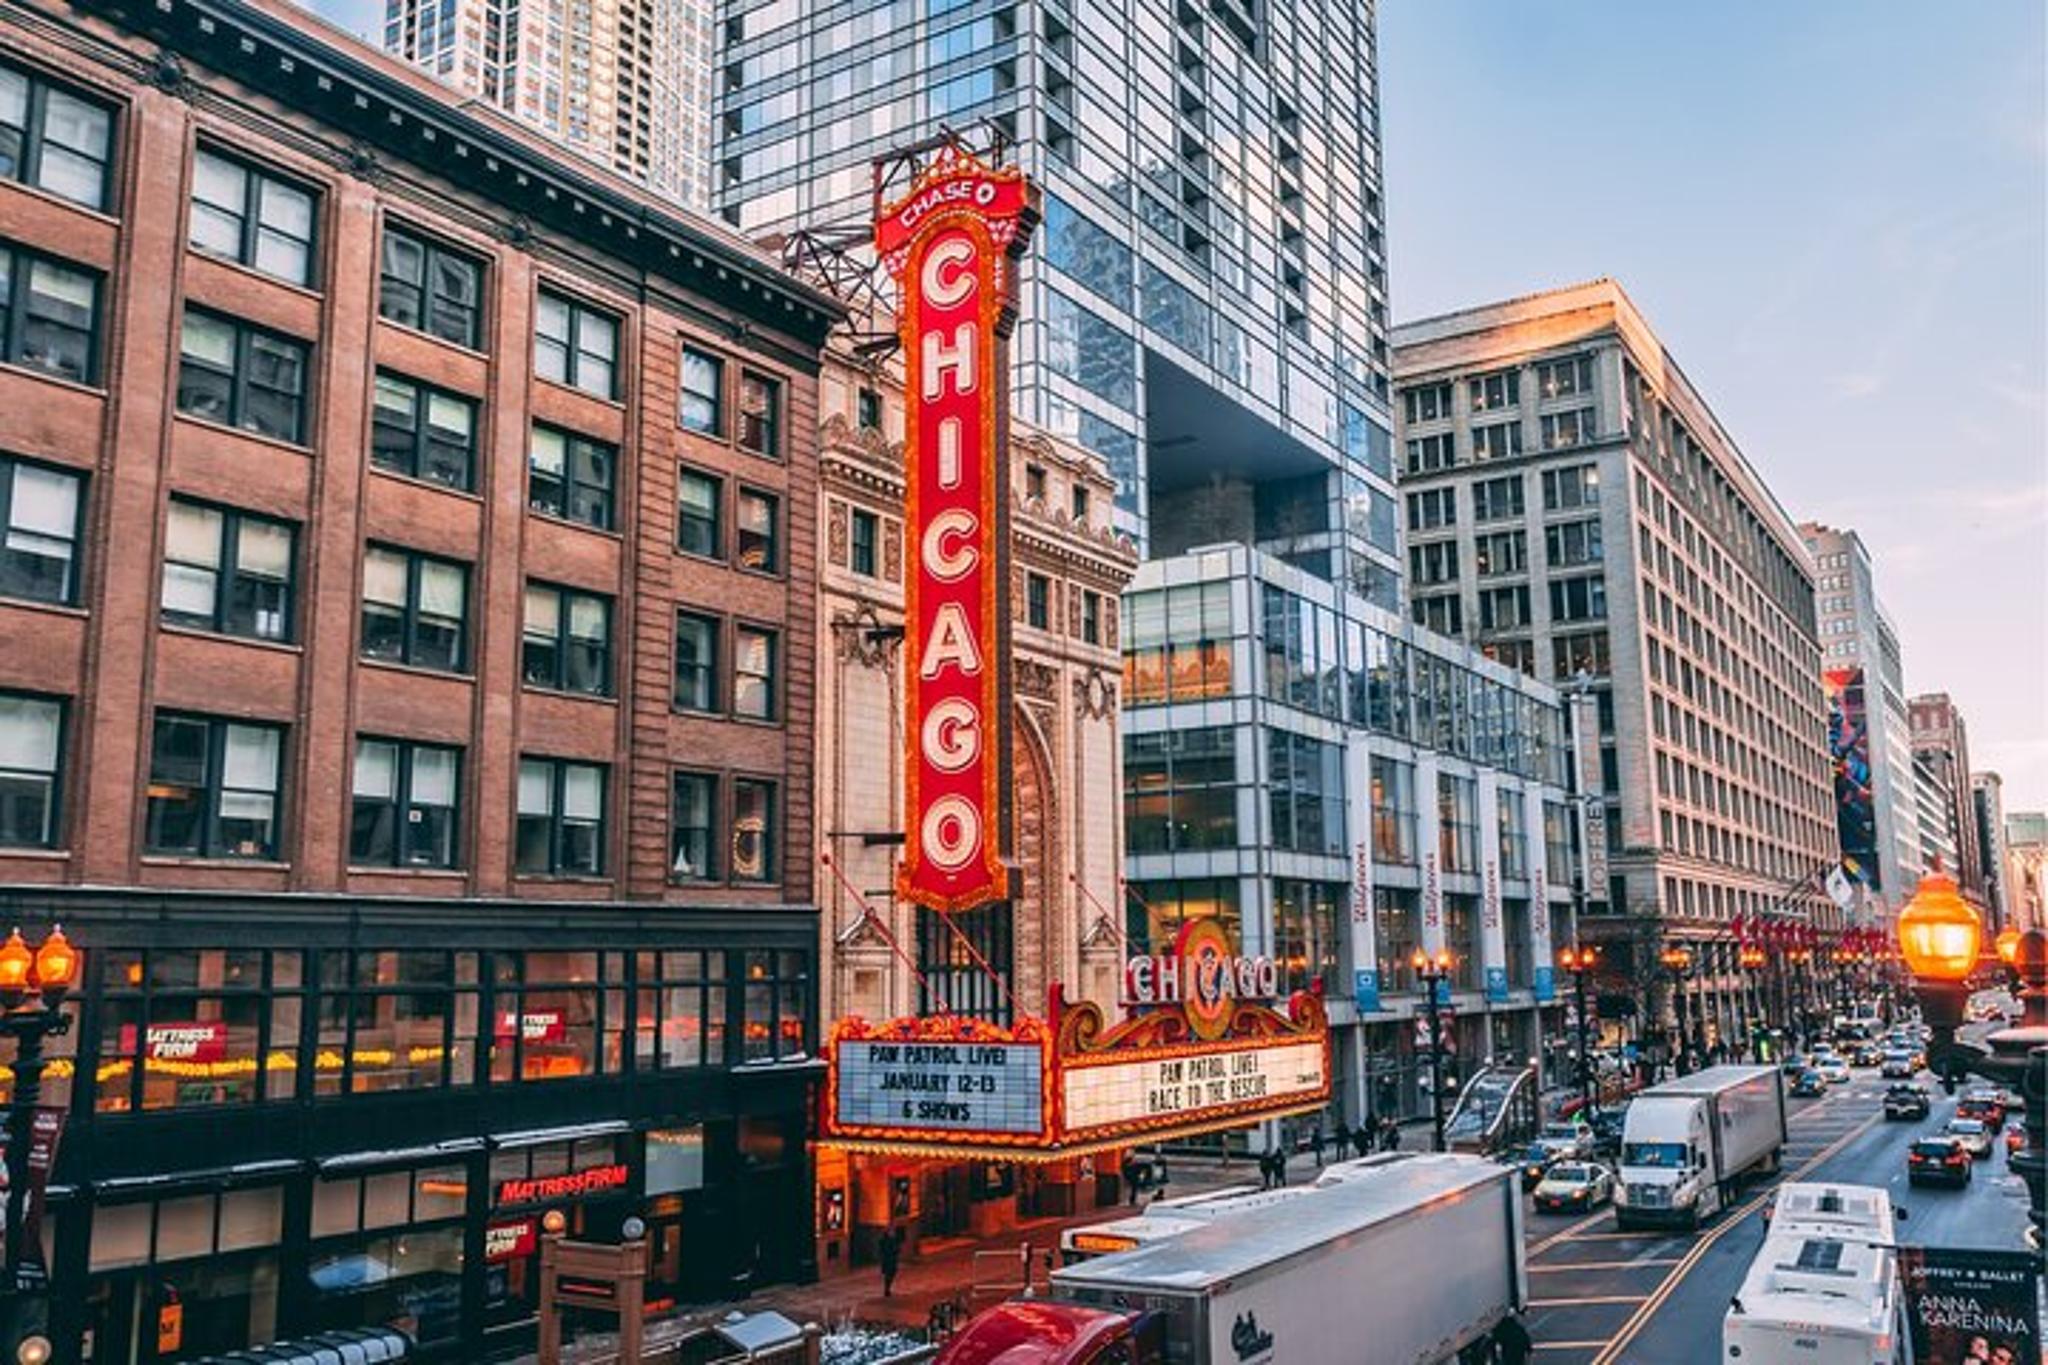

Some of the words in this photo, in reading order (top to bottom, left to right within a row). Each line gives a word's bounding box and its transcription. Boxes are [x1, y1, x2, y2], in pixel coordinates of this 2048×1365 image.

[900, 180, 974, 227] CHASE
[920, 236, 982, 872] CHICAGO
[1127, 953, 1278, 1002] CHICAGO
[153, 1042, 198, 1059] FIRM
[869, 1046, 899, 1063] PAW
[904, 1046, 962, 1065] PATROL
[969, 1047, 1008, 1065] LIVE!
[1160, 1060, 1184, 1085] PAW
[1188, 1057, 1226, 1081] PATROL
[1231, 1053, 1259, 1077] LIVE!
[880, 1072, 950, 1092] JANUARY
[957, 1074, 996, 1094] 12-13
[1150, 1086, 1181, 1113] RACE
[1187, 1085, 1201, 1107] TO
[1206, 1080, 1226, 1101] THE
[1230, 1074, 1267, 1099] RESCUE
[902, 1101, 913, 1119] 6
[917, 1102, 971, 1121] SHOWS
[1918, 1295, 1983, 1314] ANNA
[1919, 1310, 2030, 1335] KARENINA
